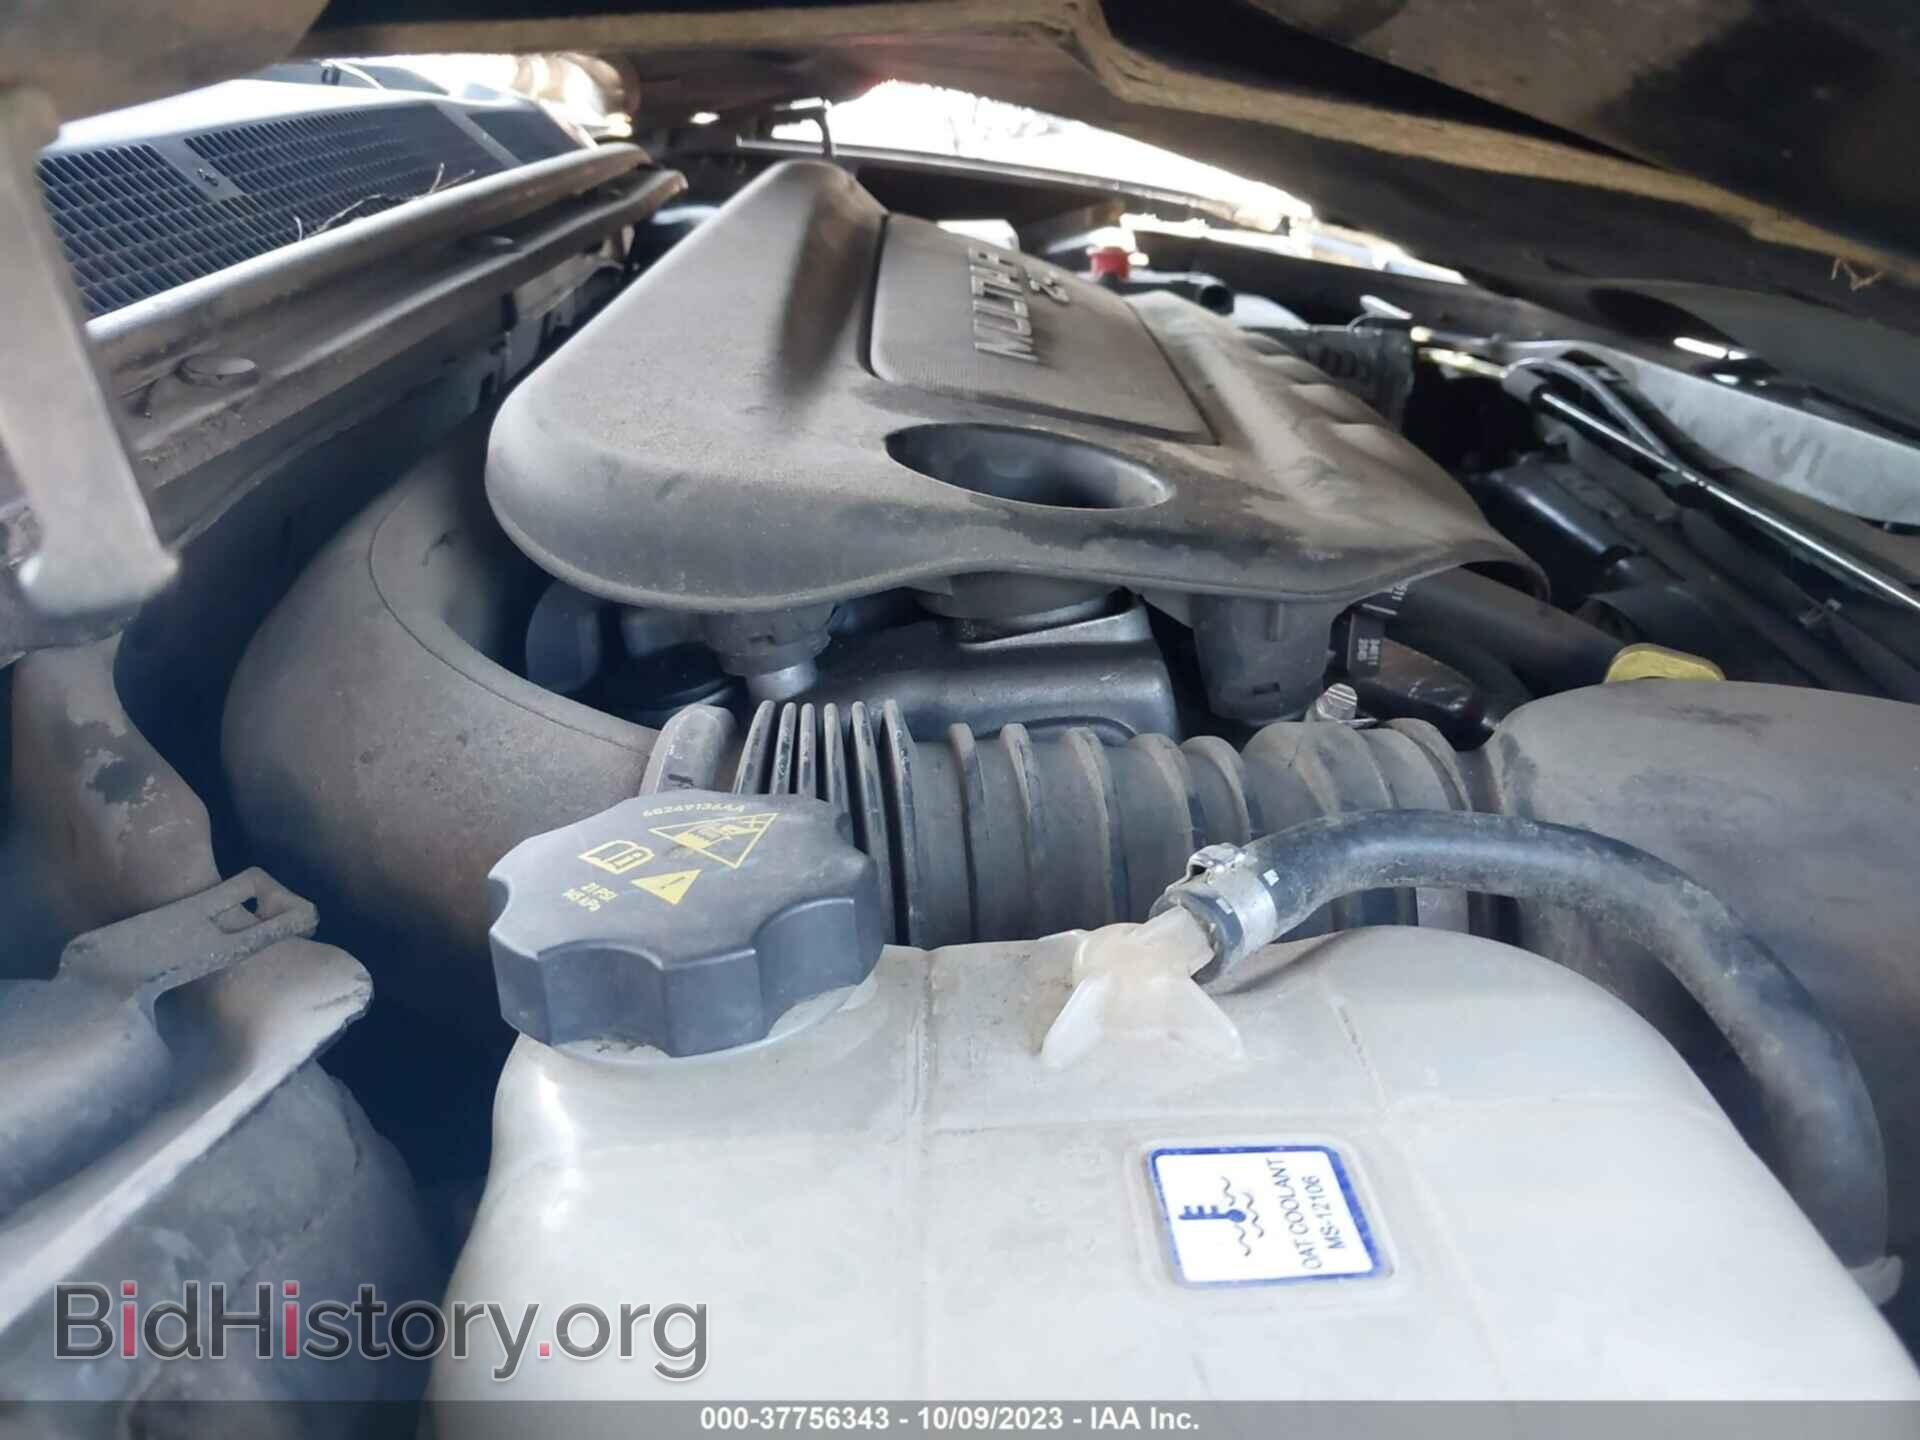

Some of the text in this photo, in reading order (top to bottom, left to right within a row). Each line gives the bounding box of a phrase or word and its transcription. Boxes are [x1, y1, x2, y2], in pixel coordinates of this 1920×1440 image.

[1265, 1157, 1322, 1269] OAT COOLANT
[1301, 1175, 1345, 1249] MS-12106
